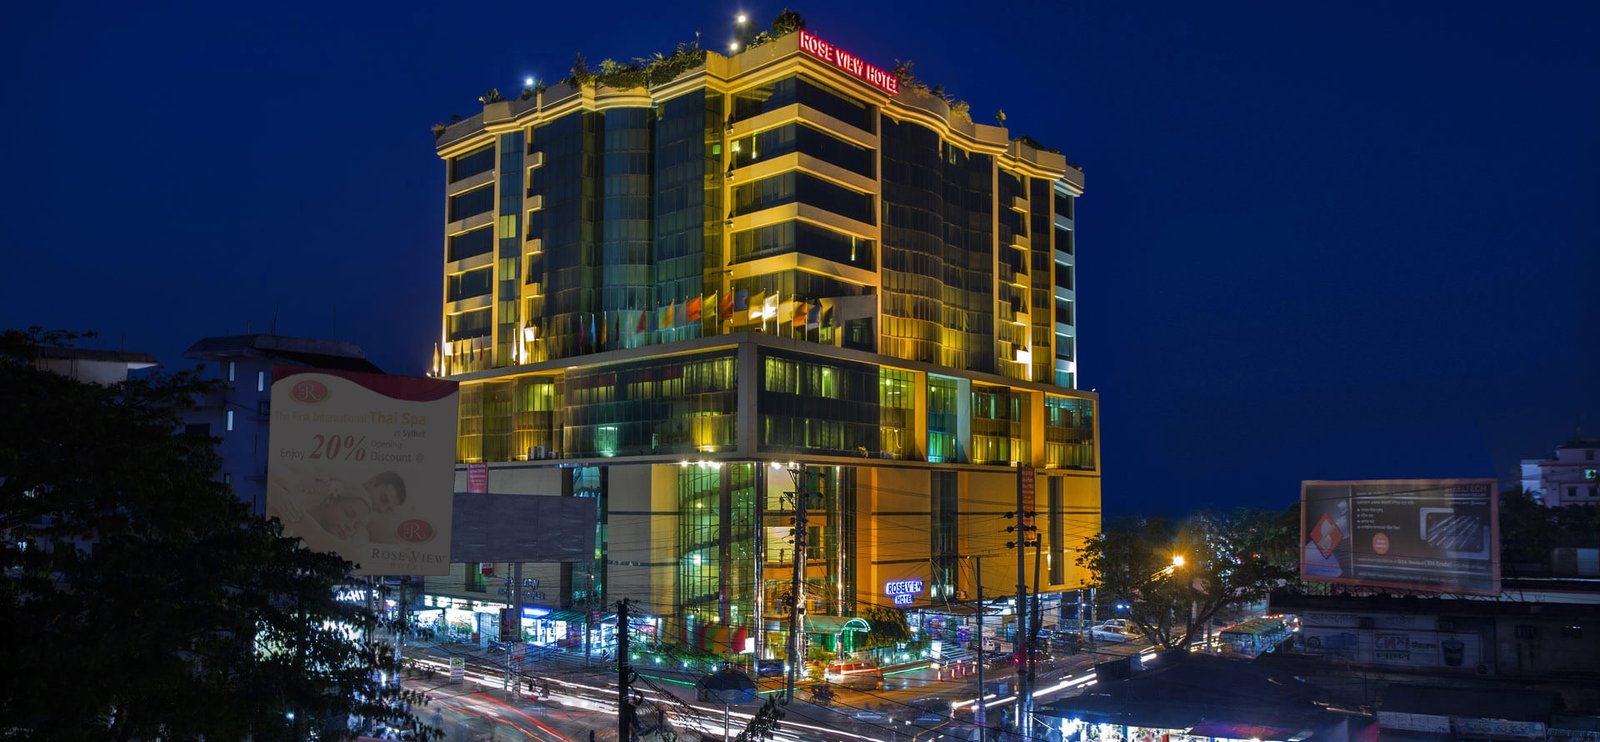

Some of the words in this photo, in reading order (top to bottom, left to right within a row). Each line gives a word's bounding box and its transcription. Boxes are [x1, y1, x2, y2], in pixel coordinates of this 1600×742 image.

[800, 30, 833, 61] ROSE
[835, 48, 864, 76] VIEW
[866, 64, 900, 94] HOTEL
[369, 411, 398, 425] Thai
[401, 413, 426, 427] Spa
[280, 447, 306, 459] Enjoy
[309, 433, 367, 462] 20%
[371, 440, 403, 449] Opening
[370, 452, 412, 463] Discount
[371, 548, 406, 561] ROSE
[408, 550, 447, 564] VIEW
[886, 581, 905, 595] ROSE
[905, 580, 923, 593] VIEW
[895, 594, 913, 605] HOTEL
